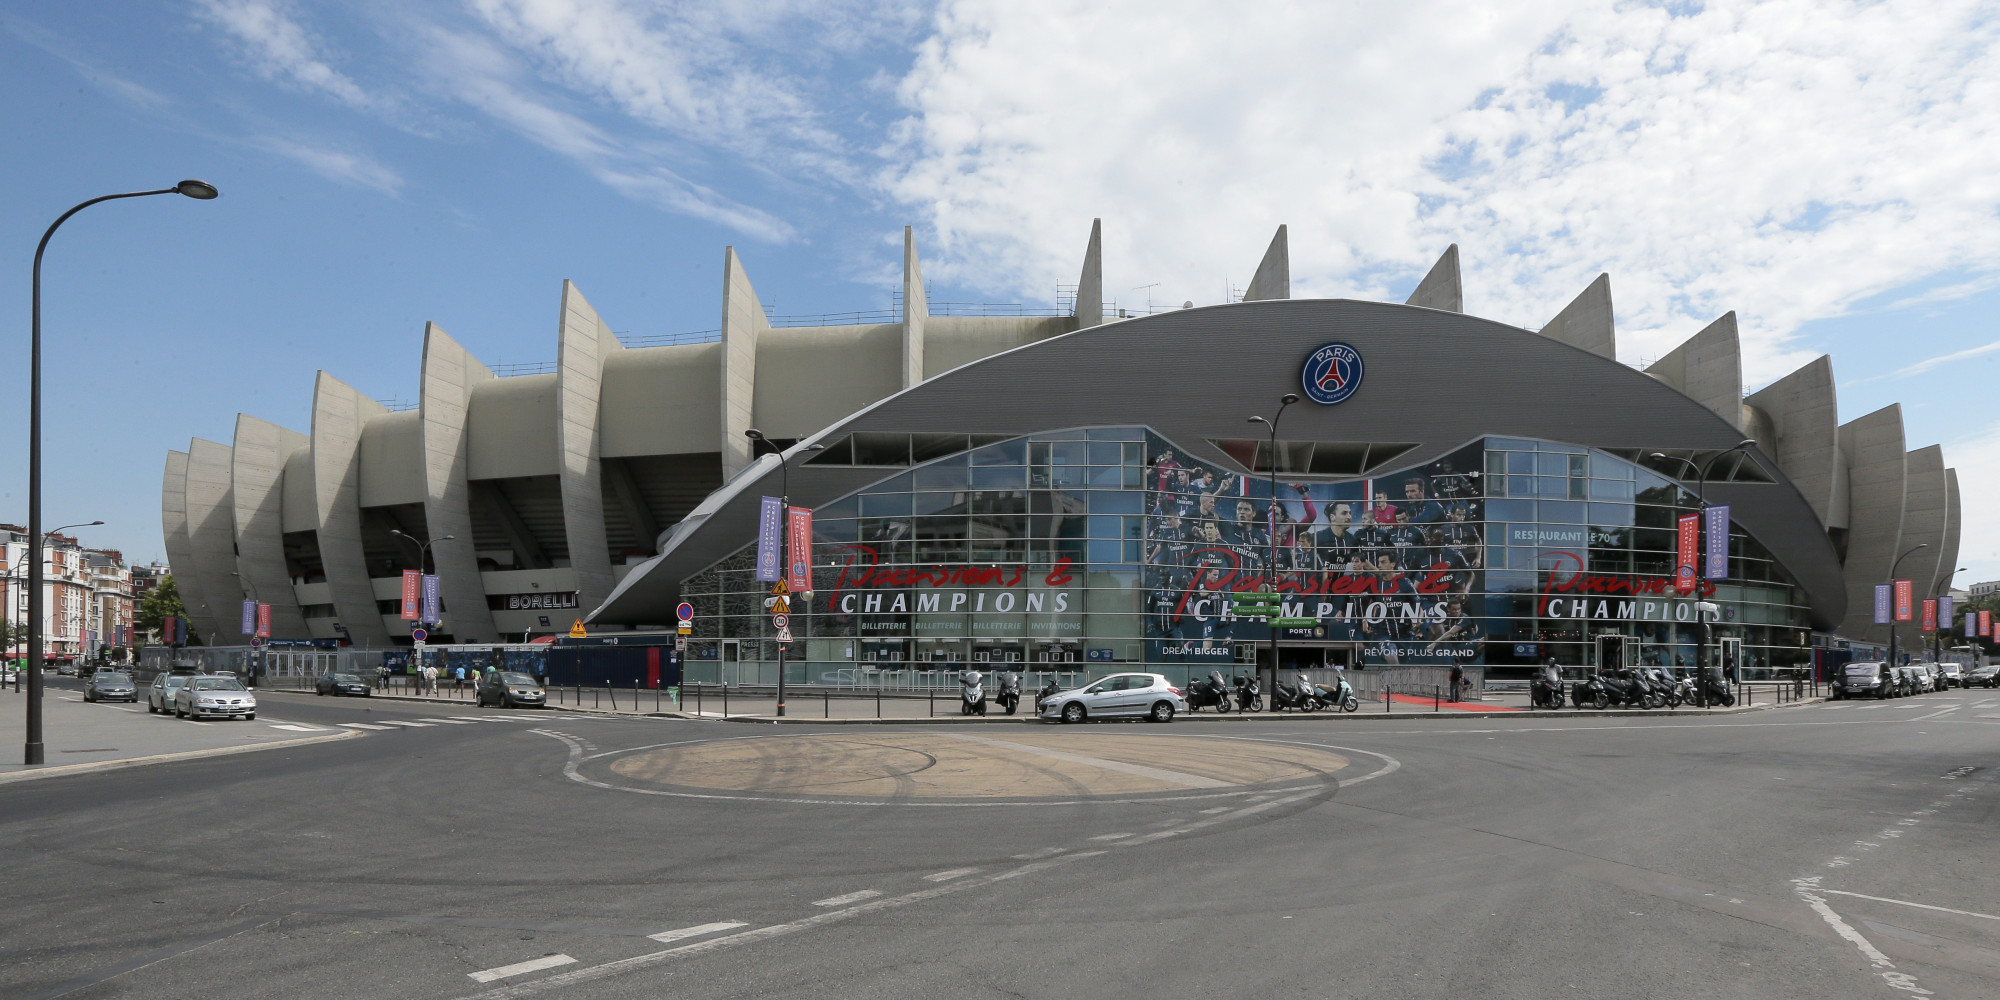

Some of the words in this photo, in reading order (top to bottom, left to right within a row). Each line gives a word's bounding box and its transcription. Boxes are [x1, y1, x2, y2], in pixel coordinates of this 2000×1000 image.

[1316, 348, 1354, 363] PARIS
[1514, 530, 1582, 542] RESTAURANT
[1598, 534, 1610, 543] 70
[1232, 544, 1259, 560] Emirates
[823, 545, 1028, 610] Parisiens
[1045, 557, 1072, 588] &
[1173, 547, 1406, 622] Parisiens
[1418, 563, 1450, 594] &
[510, 594, 576, 608] BORELLI
[841, 592, 1068, 613] CHAMPIONS
[862, 622, 906, 630] BILLETTERIE
[916, 622, 962, 630] BILLETTERIE
[973, 622, 1021, 630] BILLETTERIE
[1032, 622, 1080, 630] INVITATIONS
[1162, 647, 1192, 655] DREAM
[1194, 648, 1228, 656] BIGGER
[1364, 646, 1404, 656] RÊVONS
